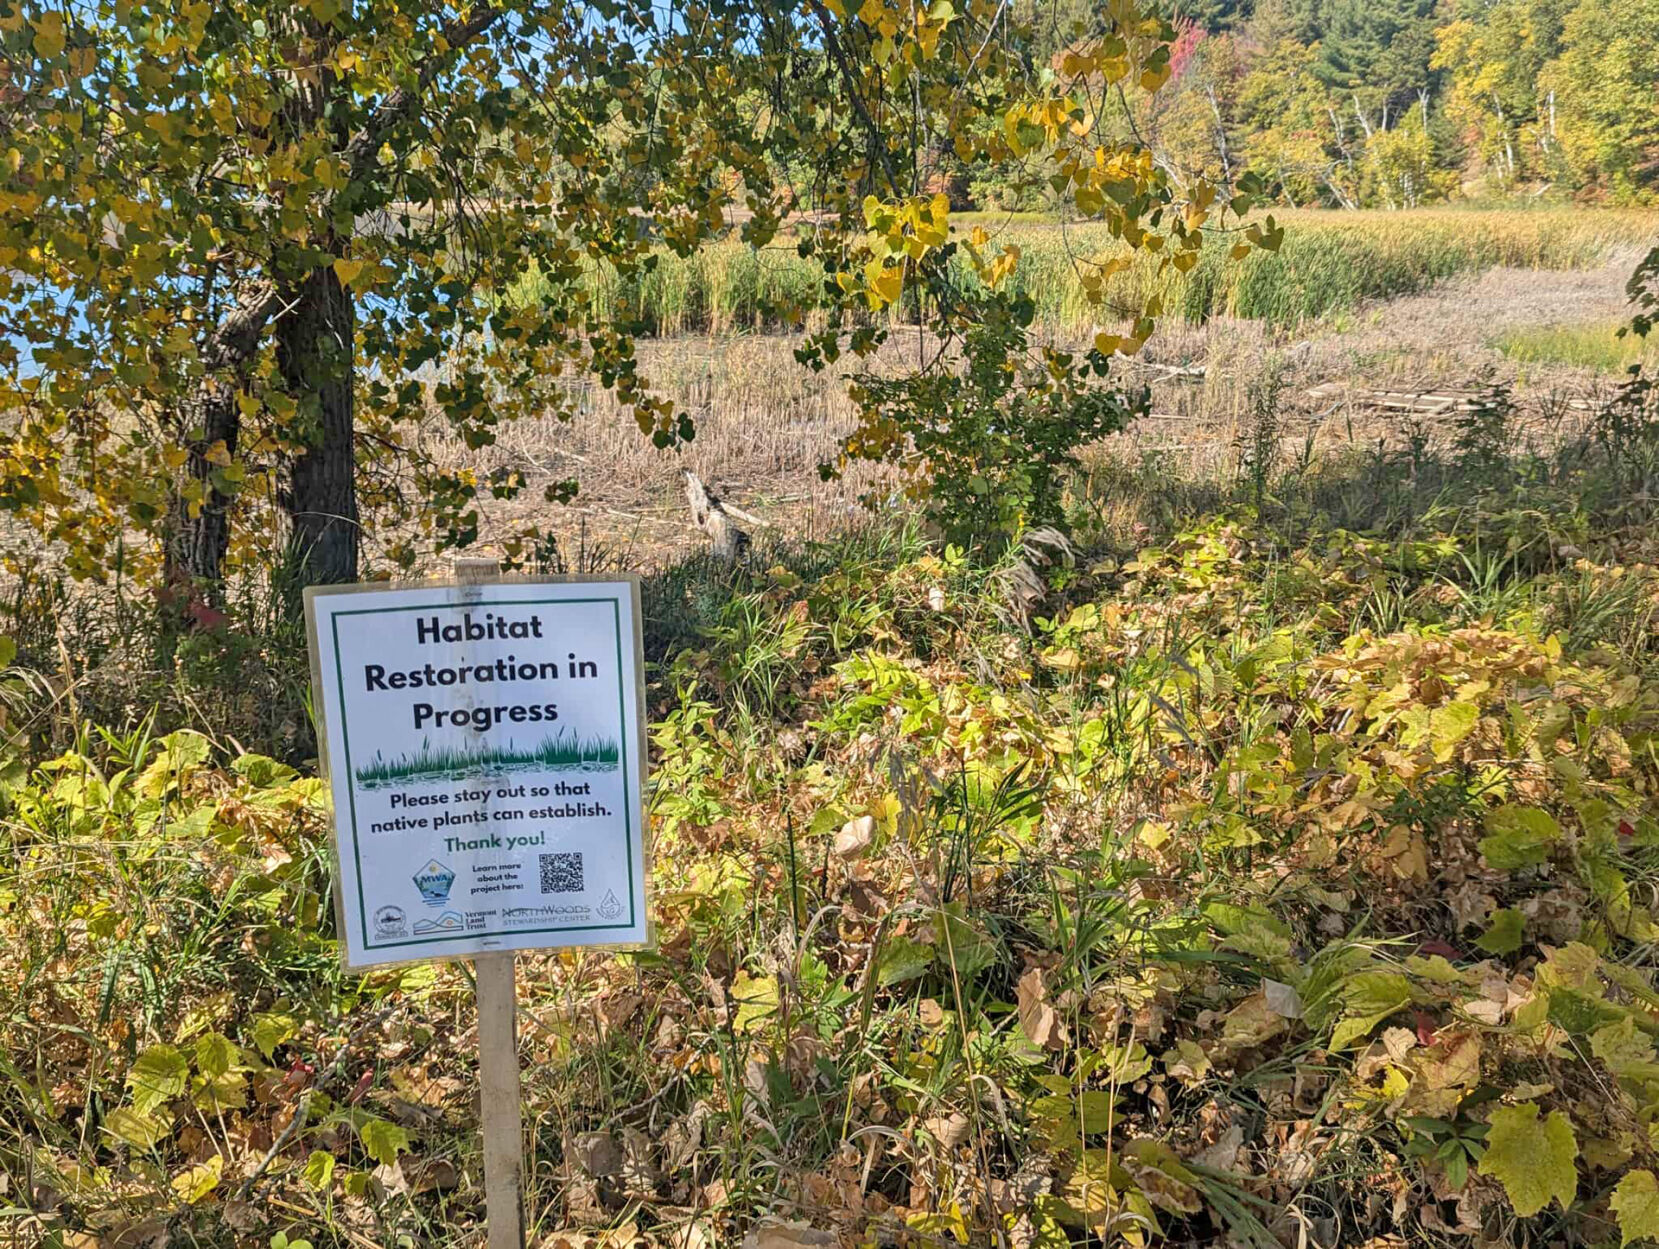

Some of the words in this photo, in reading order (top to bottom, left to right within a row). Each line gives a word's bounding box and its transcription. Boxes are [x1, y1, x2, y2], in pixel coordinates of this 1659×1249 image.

[417, 613, 543, 644] Habitat
[364, 655, 559, 692] Restoration
[568, 653, 598, 678] in
[413, 704, 558, 733] Progress
[390, 793, 449, 808] Please
[454, 788, 491, 804] stay
[497, 785, 525, 798] out
[530, 785, 550, 797] so
[554, 781, 591, 796] that
[371, 816, 428, 833] native
[433, 809, 488, 830] plants
[493, 807, 524, 821] can
[529, 802, 612, 819] establish.
[444, 834, 501, 852] Thank
[506, 831, 545, 850] you!
[420, 874, 448, 883] MWA
[477, 874, 503, 882] about
[470, 885, 500, 895] project
[502, 883, 524, 891] here:
[465, 909, 497, 917] Vermont
[465, 917, 485, 925] Land
